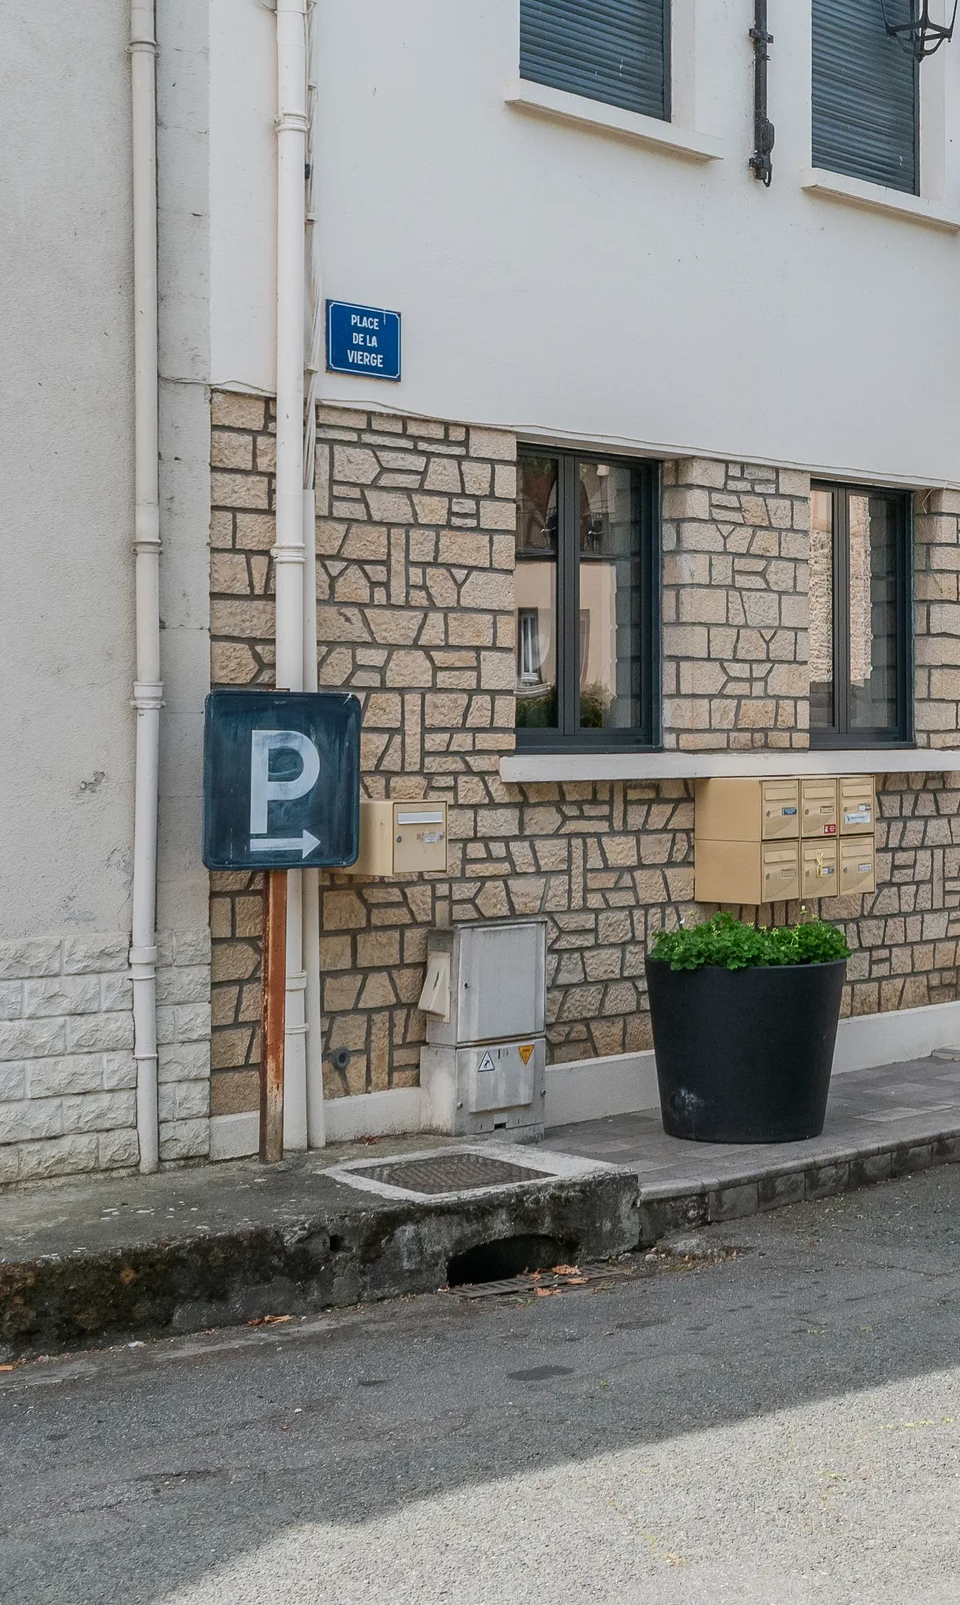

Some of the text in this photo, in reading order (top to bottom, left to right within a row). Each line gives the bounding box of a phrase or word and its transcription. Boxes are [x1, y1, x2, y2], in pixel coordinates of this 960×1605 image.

[351, 314, 379, 330] PLACE
[352, 332, 378, 348] DE LA
[347, 349, 384, 368] VIERGE
[250, 730, 320, 834] P
